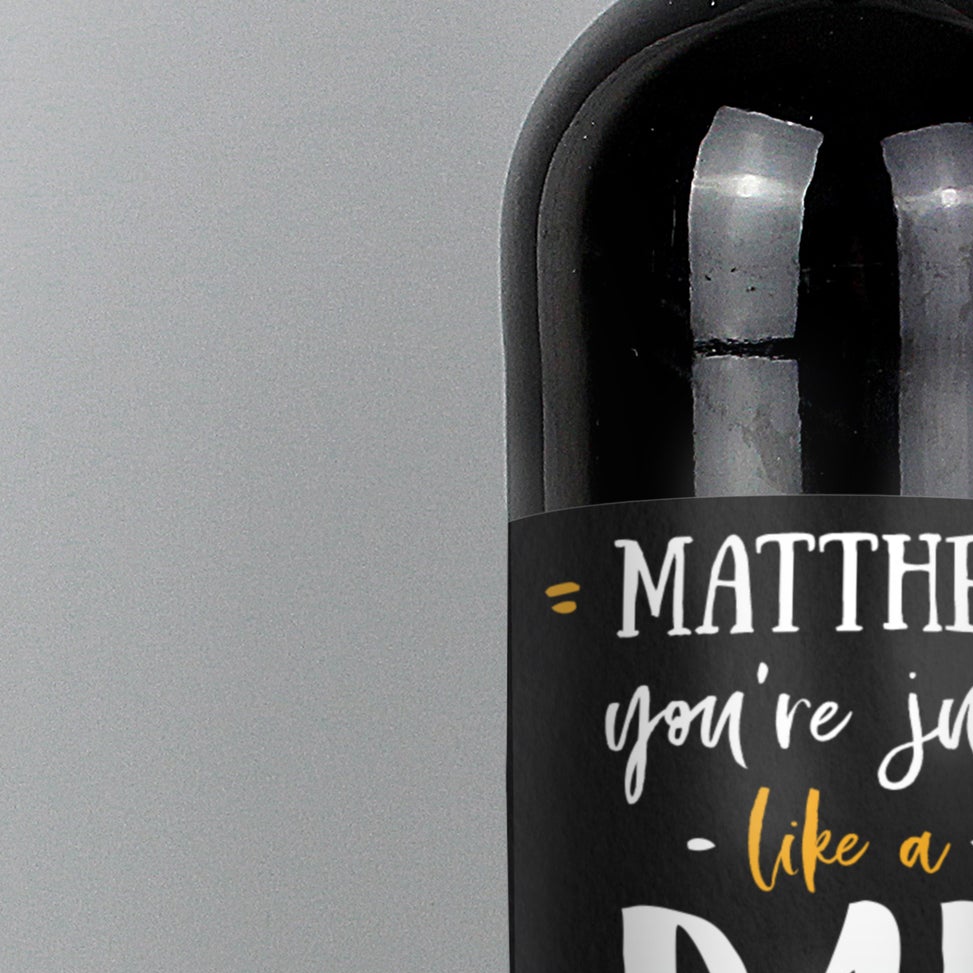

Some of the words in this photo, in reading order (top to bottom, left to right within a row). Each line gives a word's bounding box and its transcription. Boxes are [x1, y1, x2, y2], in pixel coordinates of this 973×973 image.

[604, 661, 853, 805] you're
[747, 786, 870, 894] like
[898, 830, 952, 875] a
